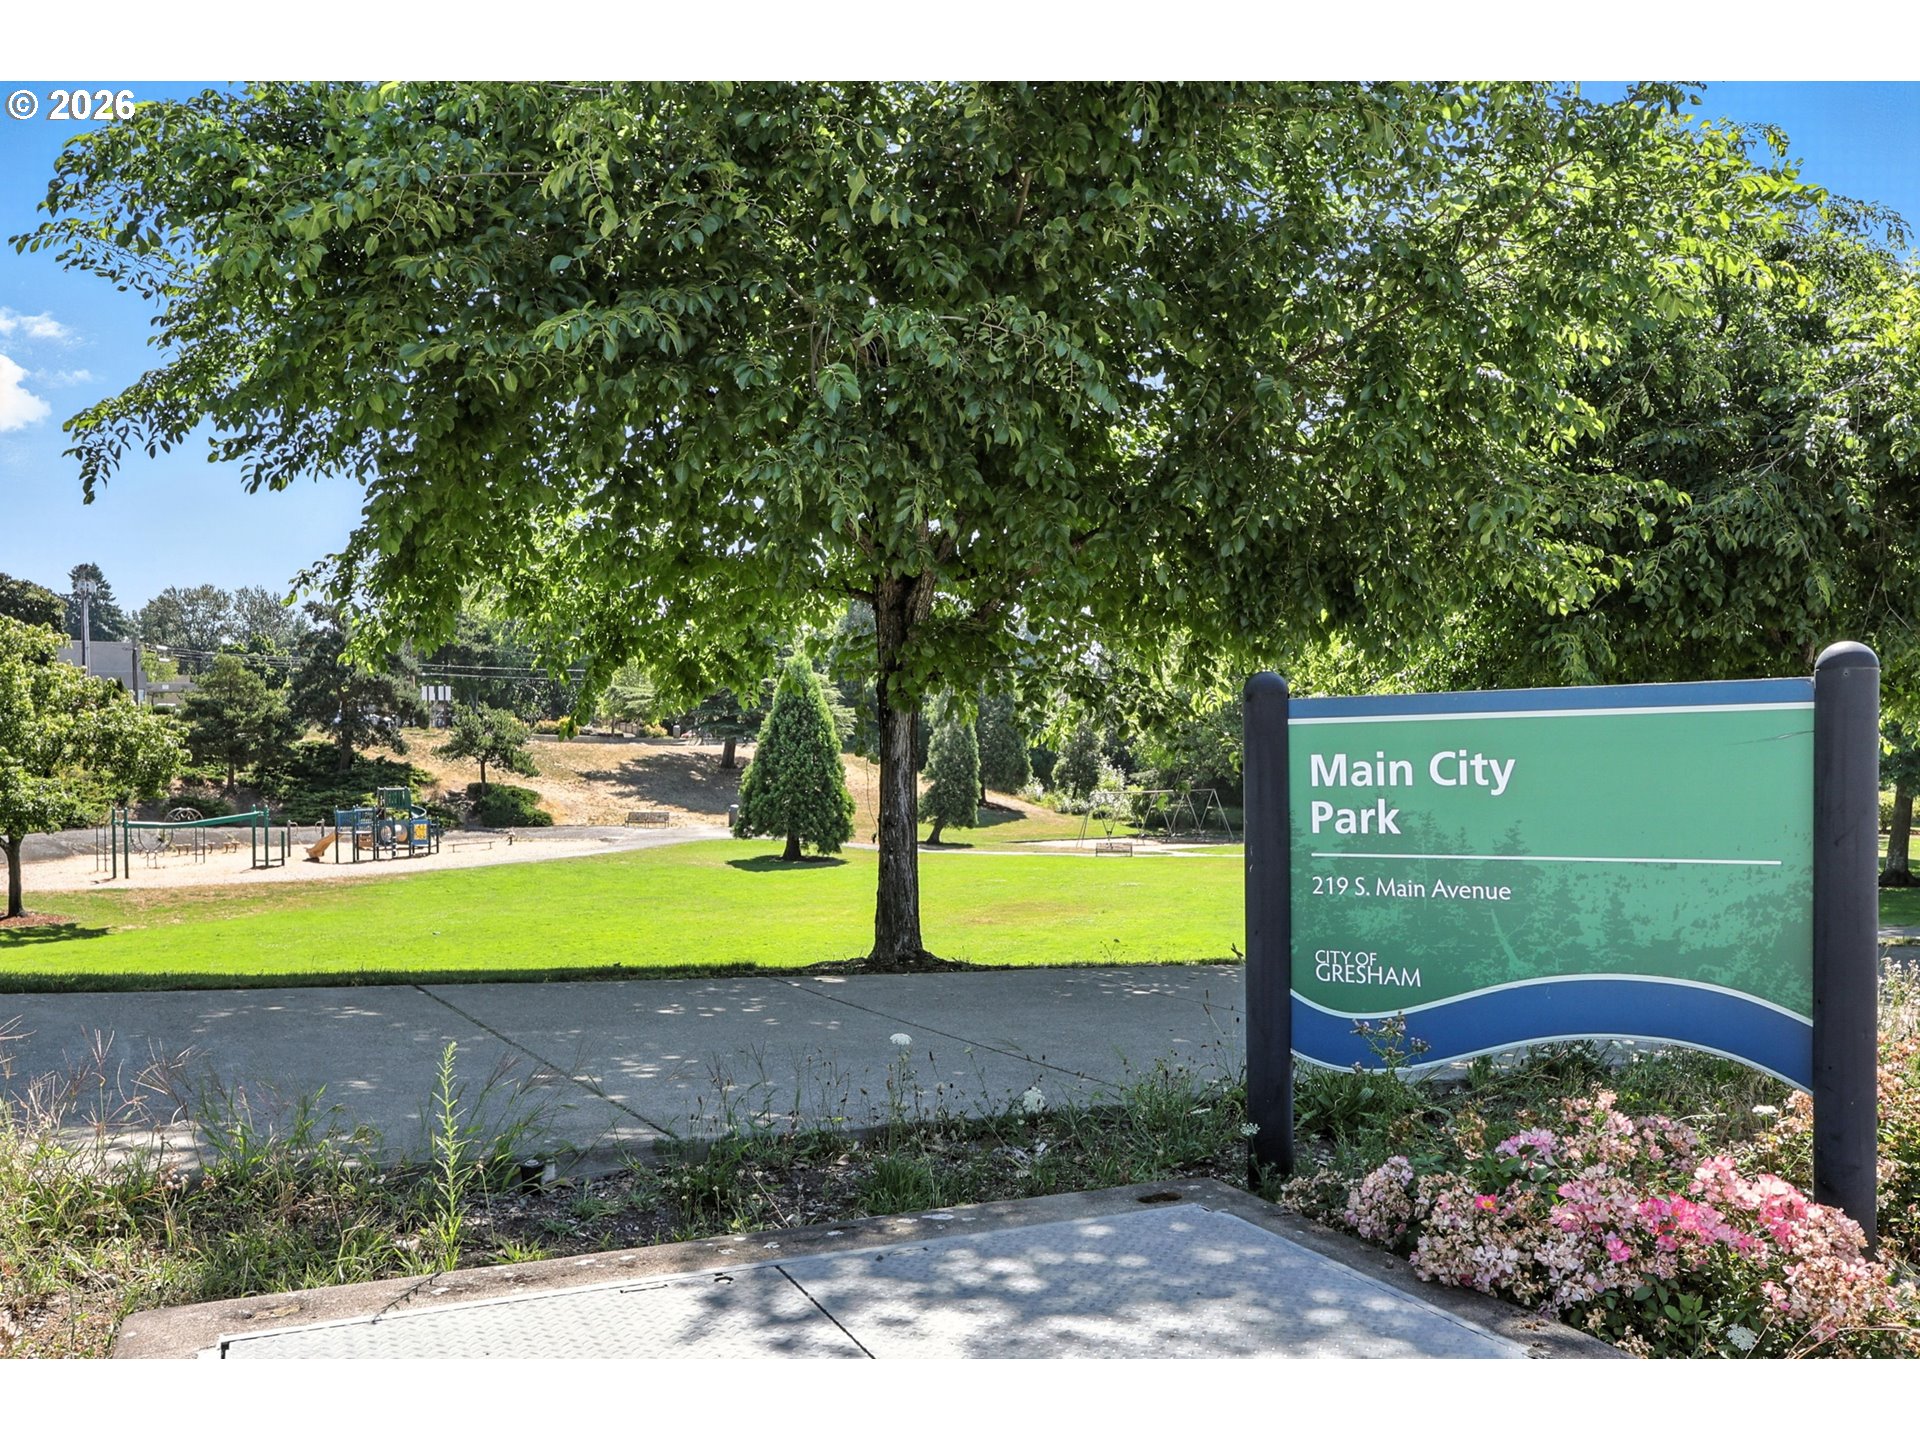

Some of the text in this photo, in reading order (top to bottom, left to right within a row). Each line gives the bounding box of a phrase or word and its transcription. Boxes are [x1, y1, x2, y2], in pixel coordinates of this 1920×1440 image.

[1310, 749, 1516, 796] Main City
[1311, 798, 1401, 834] Park
[1312, 876, 1512, 901] 219 S. Main Avenue
[1315, 949, 1378, 967] CITY OF
[1315, 963, 1422, 988] GRESHAM
